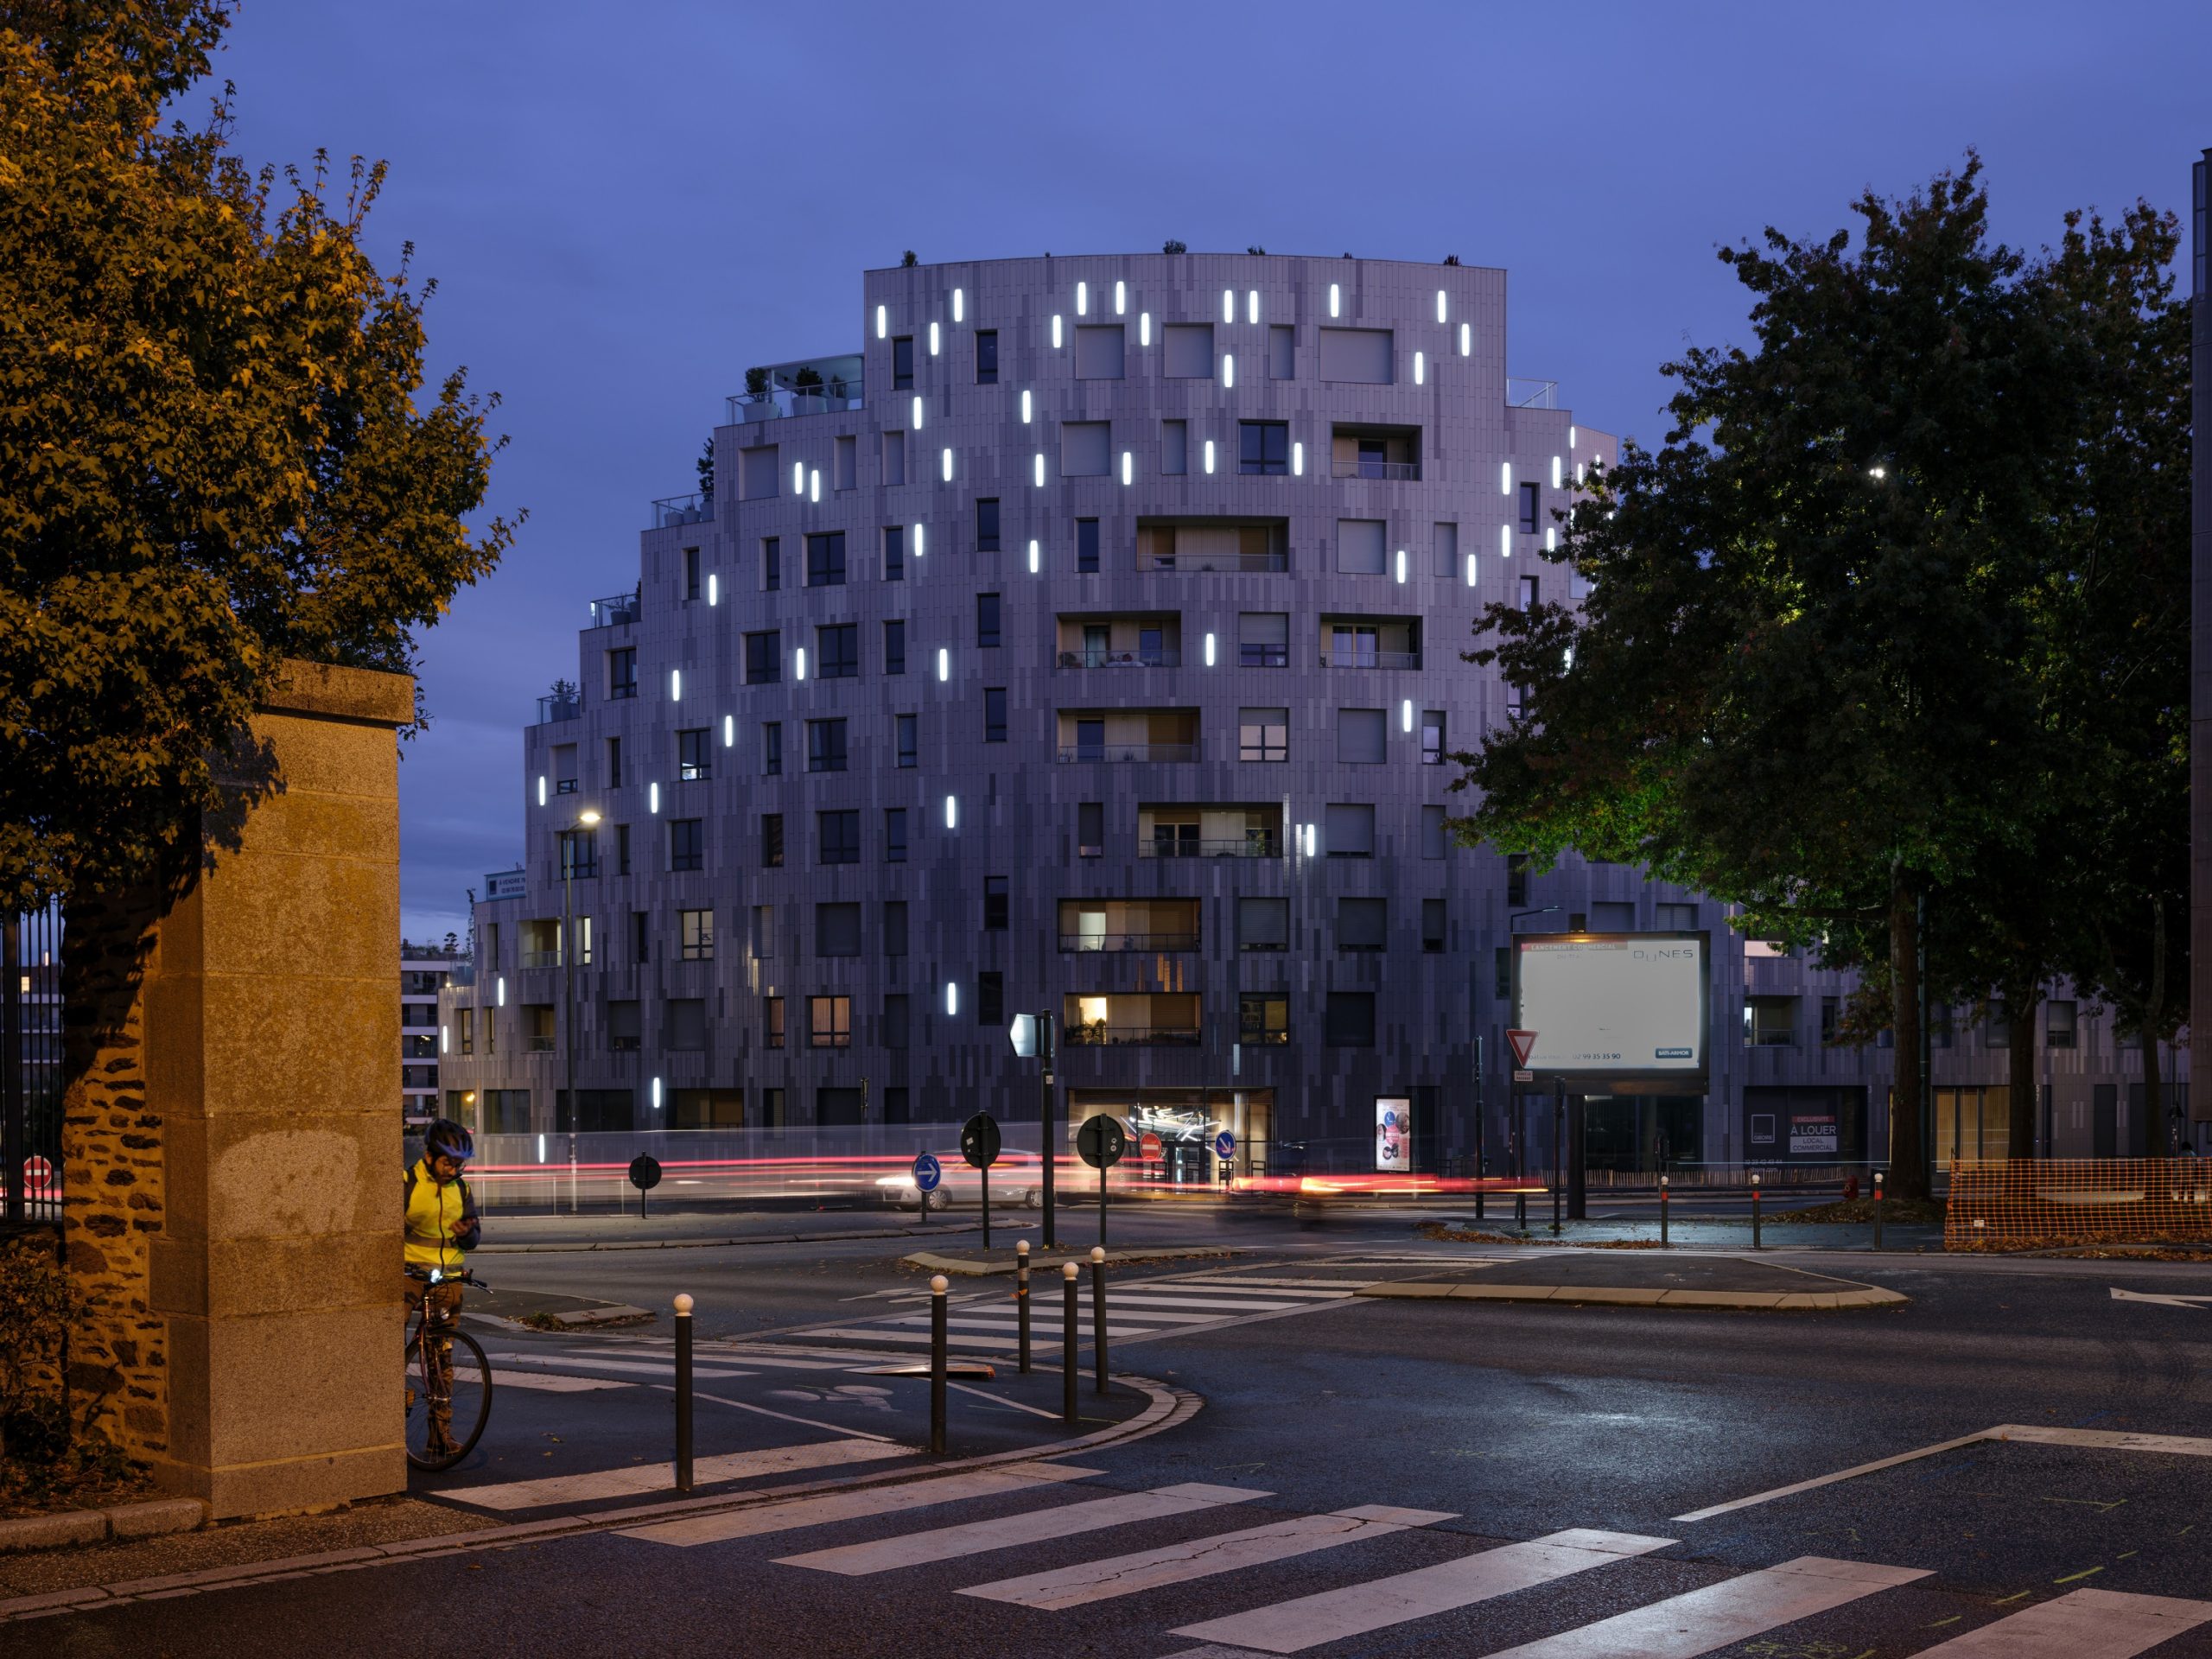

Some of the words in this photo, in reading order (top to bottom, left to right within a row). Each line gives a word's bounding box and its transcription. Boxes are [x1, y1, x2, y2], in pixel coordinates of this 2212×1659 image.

[1633, 950, 1694, 962] DUNES
[1790, 1123, 1798, 1135] À
[1801, 1125, 1837, 1135] LOUER
